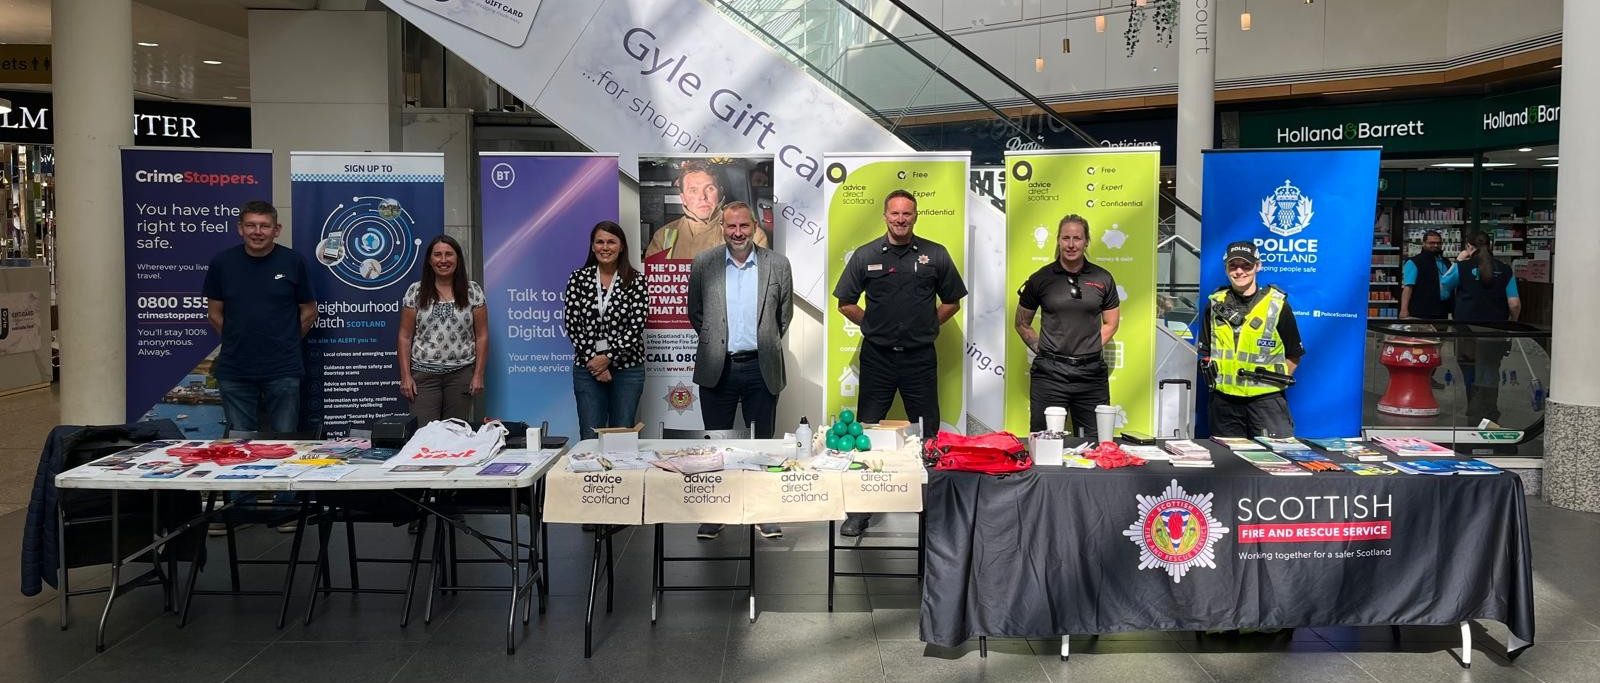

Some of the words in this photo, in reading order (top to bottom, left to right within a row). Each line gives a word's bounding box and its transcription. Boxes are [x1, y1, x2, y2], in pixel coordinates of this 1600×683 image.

[485, 0, 502, 9] GIFT
[502, 5, 524, 18] CARD
[1194, 0, 1210, 54] court
[622, 28, 702, 98] Gyle
[708, 86, 777, 150] Gift
[344, 164, 364, 172] SIGN
[367, 164, 380, 172] UP
[382, 164, 392, 172] TO
[629, 96, 709, 153] shoppin
[782, 206, 824, 245] easy
[136, 170, 258, 186] CrimeStoppers.
[497, 170, 510, 180] BT
[136, 203, 167, 216] You
[172, 203, 210, 216] have
[214, 204, 240, 216] the
[137, 220, 176, 234] right
[180, 222, 196, 232] to
[200, 220, 228, 232] feel
[136, 236, 172, 248] safe.
[1253, 238, 1318, 252] POLICE
[1260, 253, 1318, 263] COTLAND
[137, 263, 176, 271] Wherever
[179, 264, 194, 272] you
[196, 263, 209, 271] live
[679, 264, 691, 272] BE
[507, 288, 538, 301] Talk
[542, 290, 556, 301] to
[648, 285, 678, 293] COOK
[137, 296, 178, 308] 0800
[658, 296, 683, 304] WAS
[316, 301, 399, 315] eighbourhood
[138, 311, 208, 320] crimestoppers-
[508, 308, 550, 322] today
[164, 329, 183, 338] stay
[508, 326, 554, 340] Digital
[138, 348, 172, 357] Always.
[508, 353, 529, 361] Your
[550, 353, 576, 361] home
[646, 354, 674, 362] CALL
[676, 354, 698, 362] 080
[508, 364, 537, 374] phone
[584, 473, 622, 484] advice
[684, 473, 722, 484] advice
[781, 472, 819, 483] advice
[584, 483, 614, 494] direct
[684, 483, 716, 494] direct
[781, 482, 812, 493] direct
[860, 482, 908, 492] scotland
[582, 494, 631, 505] scotland
[683, 493, 731, 504] scotland
[781, 492, 828, 503] scotland
[1156, 501, 1194, 512] SCOTTISH
[1238, 494, 1392, 522] SCOTTISH
[1242, 528, 1265, 538] FIRE
[1268, 528, 1293, 538] AND
[1296, 527, 1340, 537] RESCUE
[1343, 526, 1387, 536] SERVICE
[1165, 553, 1192, 562] RESCUE
[1239, 552, 1273, 561] Working
[1275, 551, 1311, 560] together
[1313, 550, 1325, 559] for
[1334, 550, 1354, 558] safer
[1356, 548, 1392, 558] Scotland
